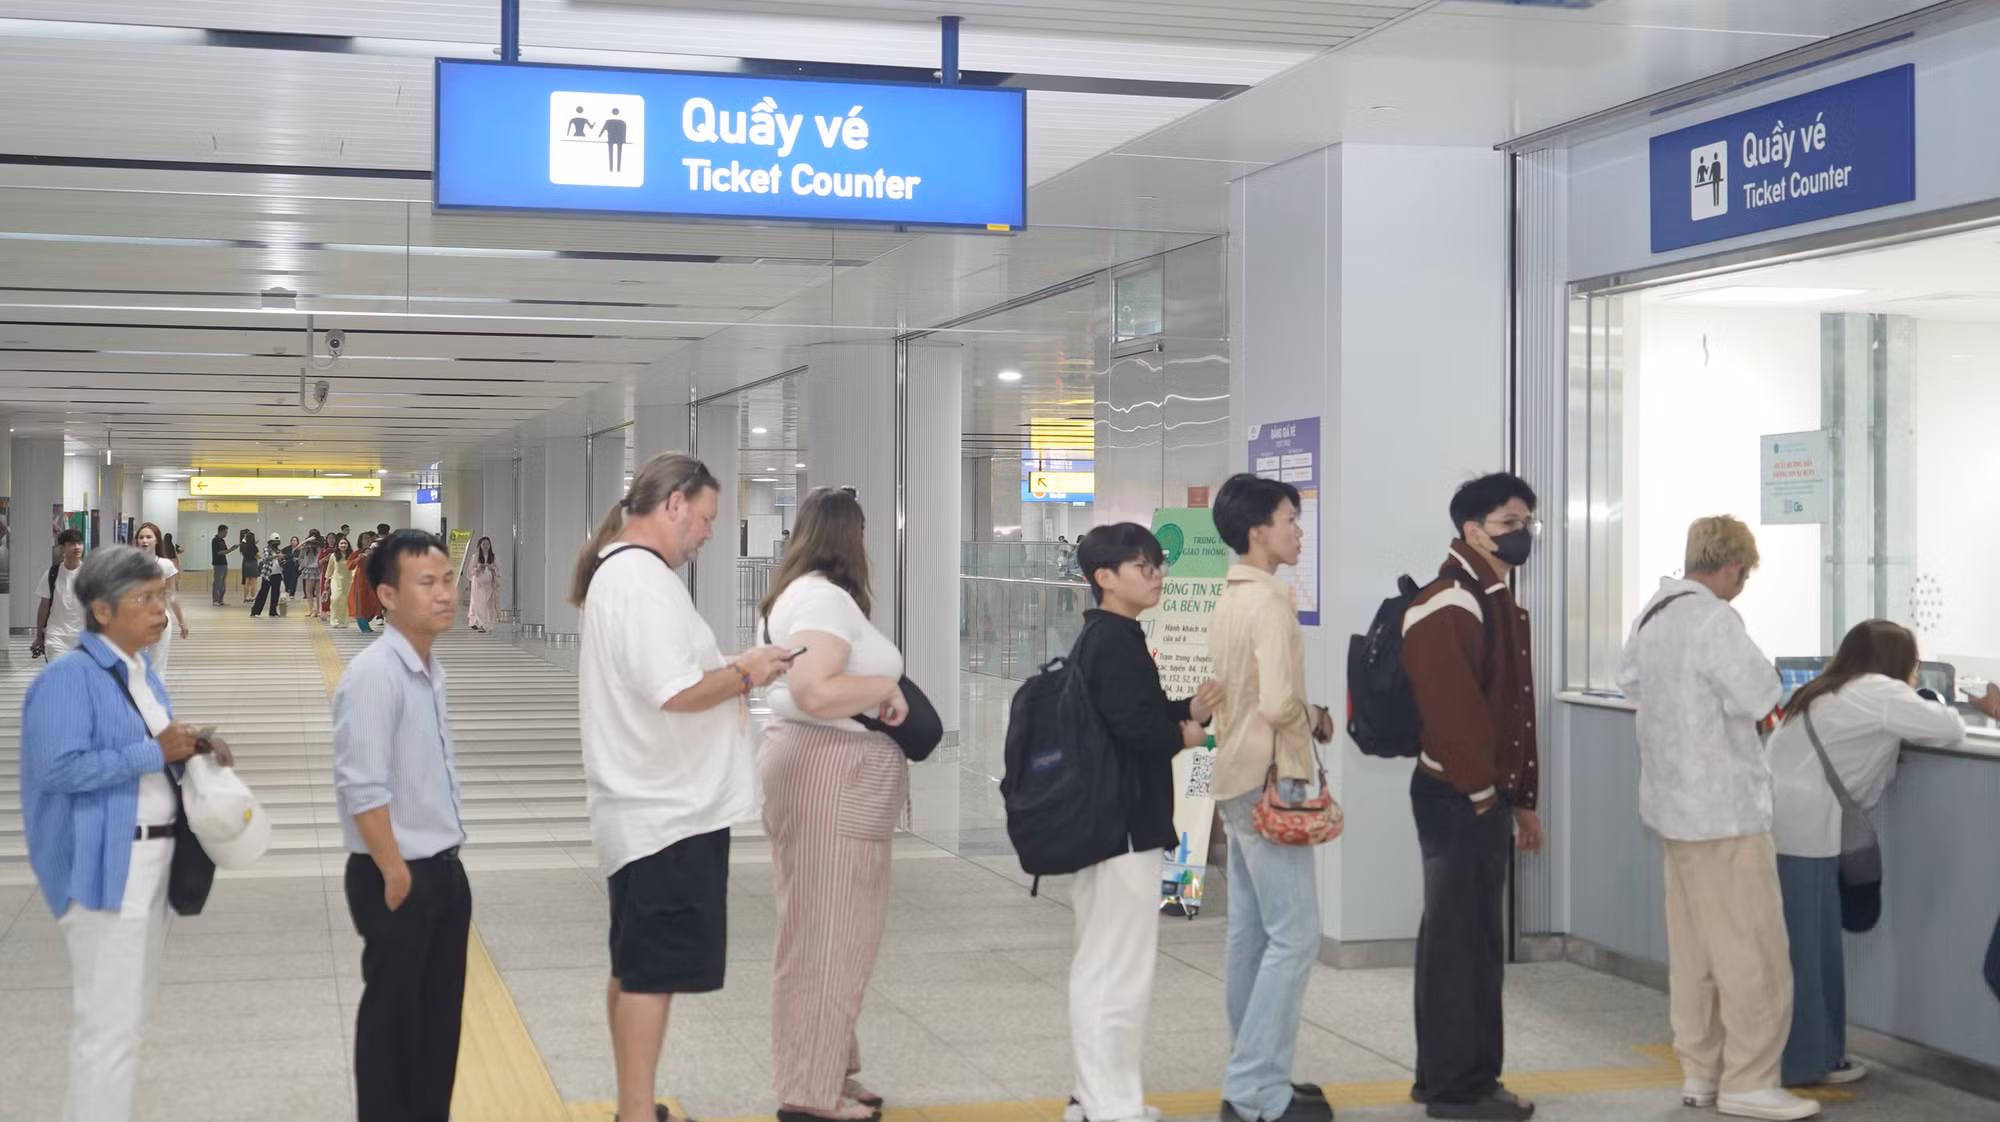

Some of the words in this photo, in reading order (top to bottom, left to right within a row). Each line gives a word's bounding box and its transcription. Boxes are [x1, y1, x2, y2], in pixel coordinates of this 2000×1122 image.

[682, 96, 802, 157] Quầy
[815, 105, 869, 150] vé
[1743, 119, 1796, 169] Quầy
[1800, 112, 1826, 152] vé
[682, 158, 781, 194] Ticket
[791, 163, 921, 200] Counter
[1743, 174, 1787, 209] Ticket
[1790, 163, 1852, 198] Counter
[1193, 536, 1217, 545] TRUNG
[1162, 599, 1177, 612] GA
[1192, 583, 1208, 596] TIN
[1209, 583, 1224, 596] XE
